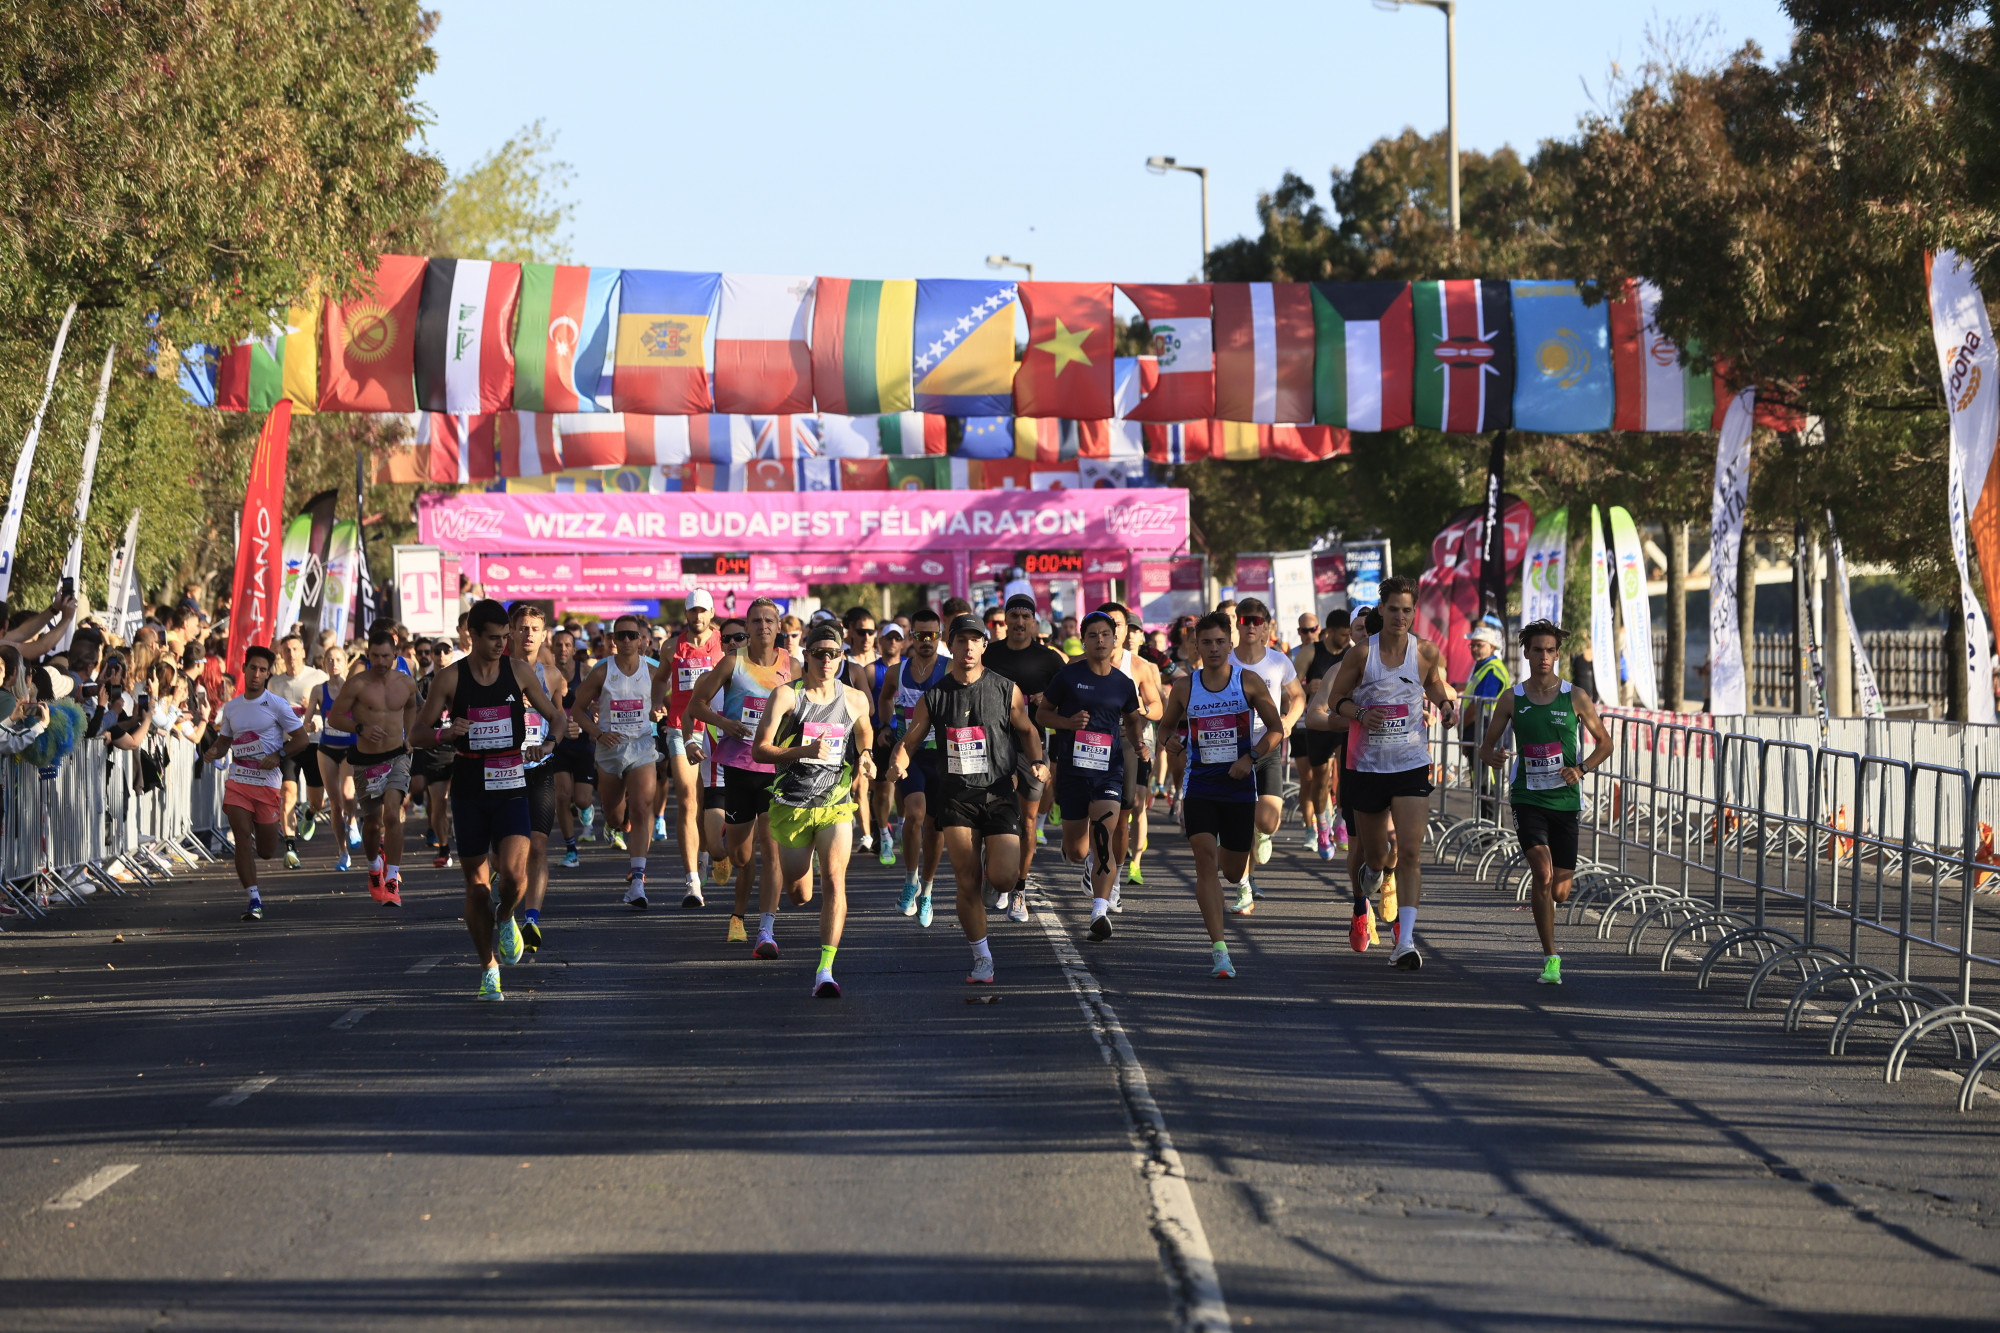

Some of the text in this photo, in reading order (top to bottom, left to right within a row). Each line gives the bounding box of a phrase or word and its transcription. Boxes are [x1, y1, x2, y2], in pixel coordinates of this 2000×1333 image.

[524, 503, 1085, 538] WIZZ AIR BUDAPEST FÉLMARATON
[716, 557, 749, 575] 0:44
[1025, 554, 1083, 573] 8:00:44
[402, 571, 439, 615] T
[1193, 700, 1239, 711] GANZAIR
[473, 725, 499, 735] 21735
[1207, 731, 1231, 739] 12202
[236, 745, 256, 755] 21780
[1084, 745, 1105, 755] 12832
[1535, 758, 1557, 767] 17833
[242, 768, 261, 777] 21780
[494, 769, 518, 778] 21735
